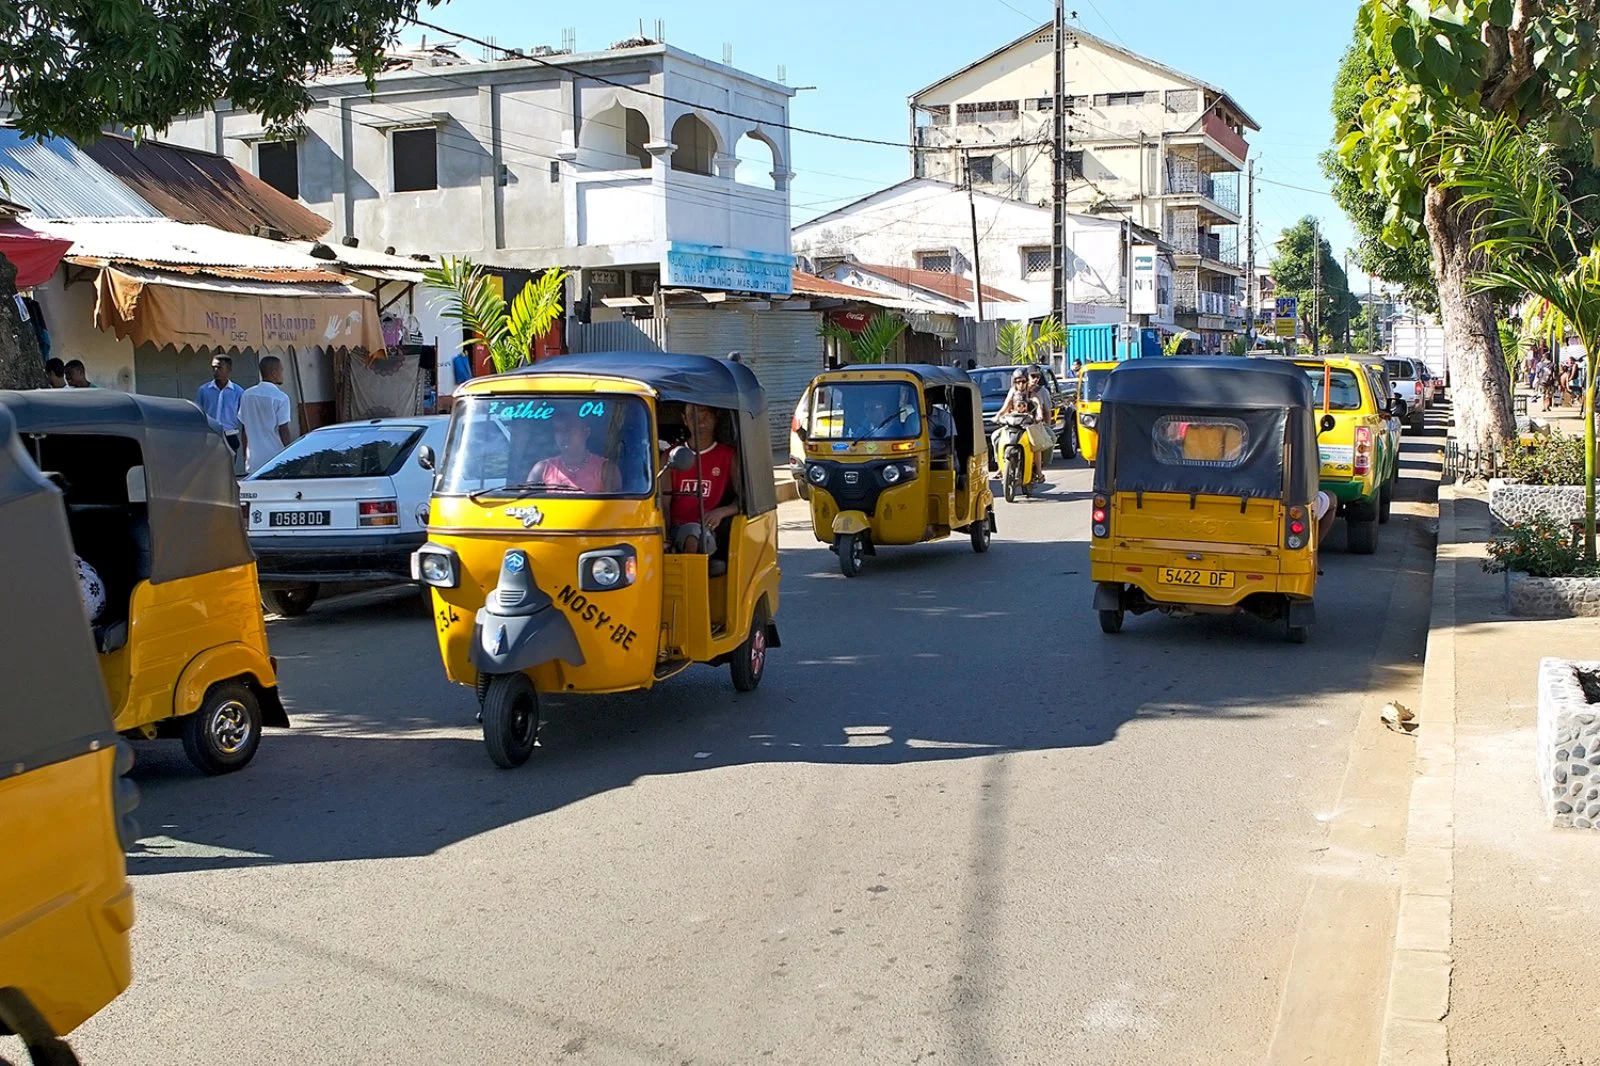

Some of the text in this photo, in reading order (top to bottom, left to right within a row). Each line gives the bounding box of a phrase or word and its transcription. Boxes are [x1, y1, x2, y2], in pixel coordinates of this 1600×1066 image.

[206, 311, 316, 336] Nipé Nikoupé
[231, 331, 248, 342] CHEZ
[578, 401, 605, 418] 04
[276, 512, 305, 526] 0588
[1165, 569, 1228, 587] 5422 DF
[558, 585, 637, 651] NOSY-BE
